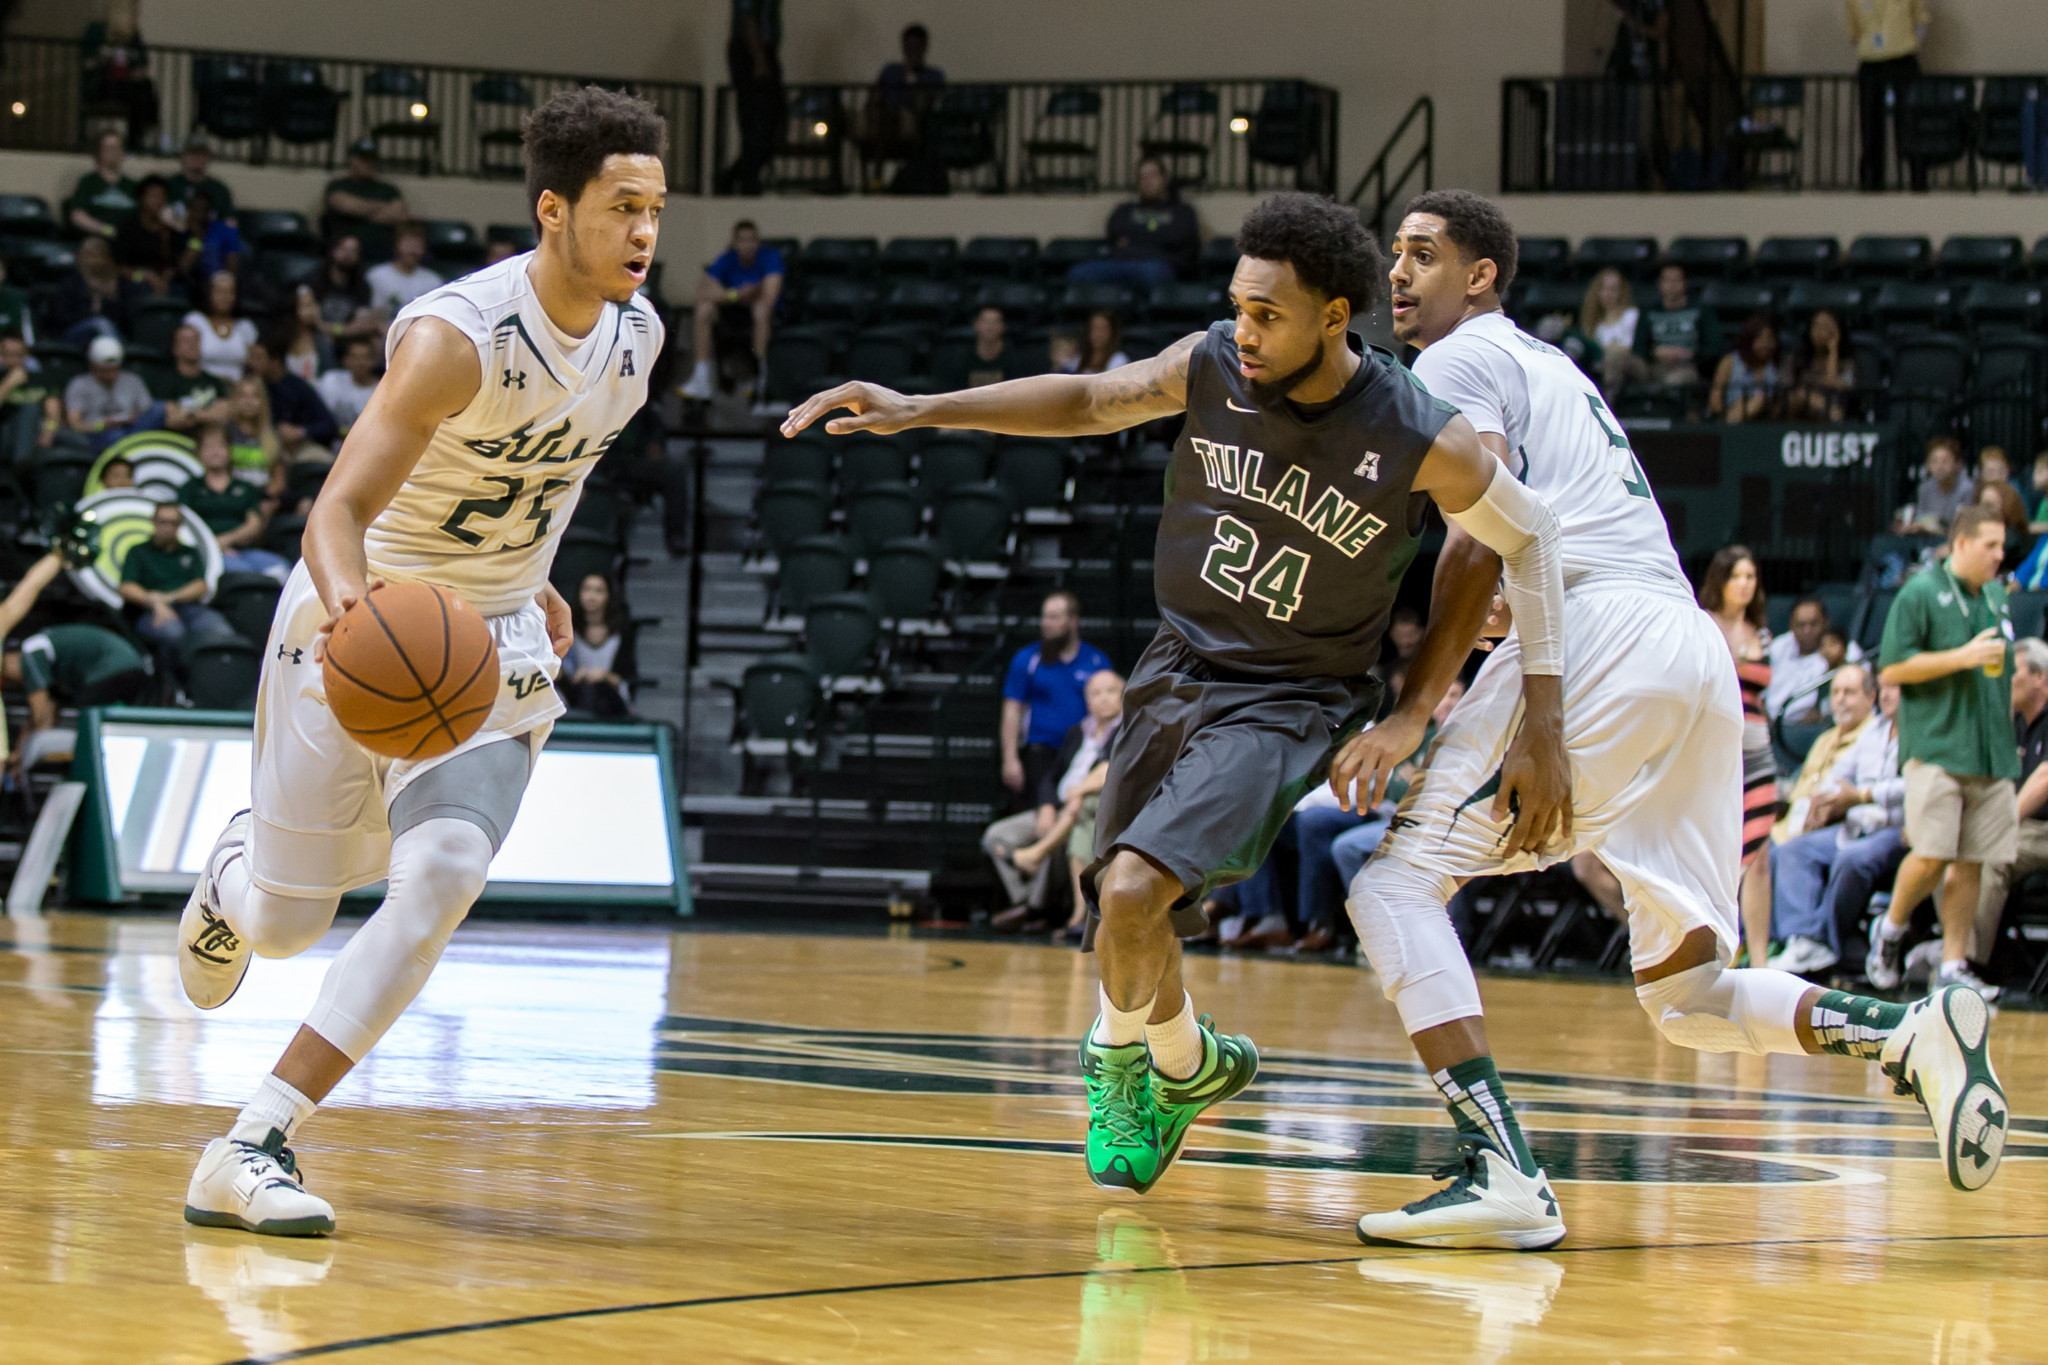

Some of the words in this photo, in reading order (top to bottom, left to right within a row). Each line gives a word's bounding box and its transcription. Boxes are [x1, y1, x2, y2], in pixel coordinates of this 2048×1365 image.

[463, 416, 623, 465] BULLS
[1578, 388, 1653, 503] 5
[1781, 430, 1880, 469] GUEST
[438, 474, 578, 553] 25
[1190, 436, 1389, 560] TULANE
[1200, 514, 1312, 623] 24
